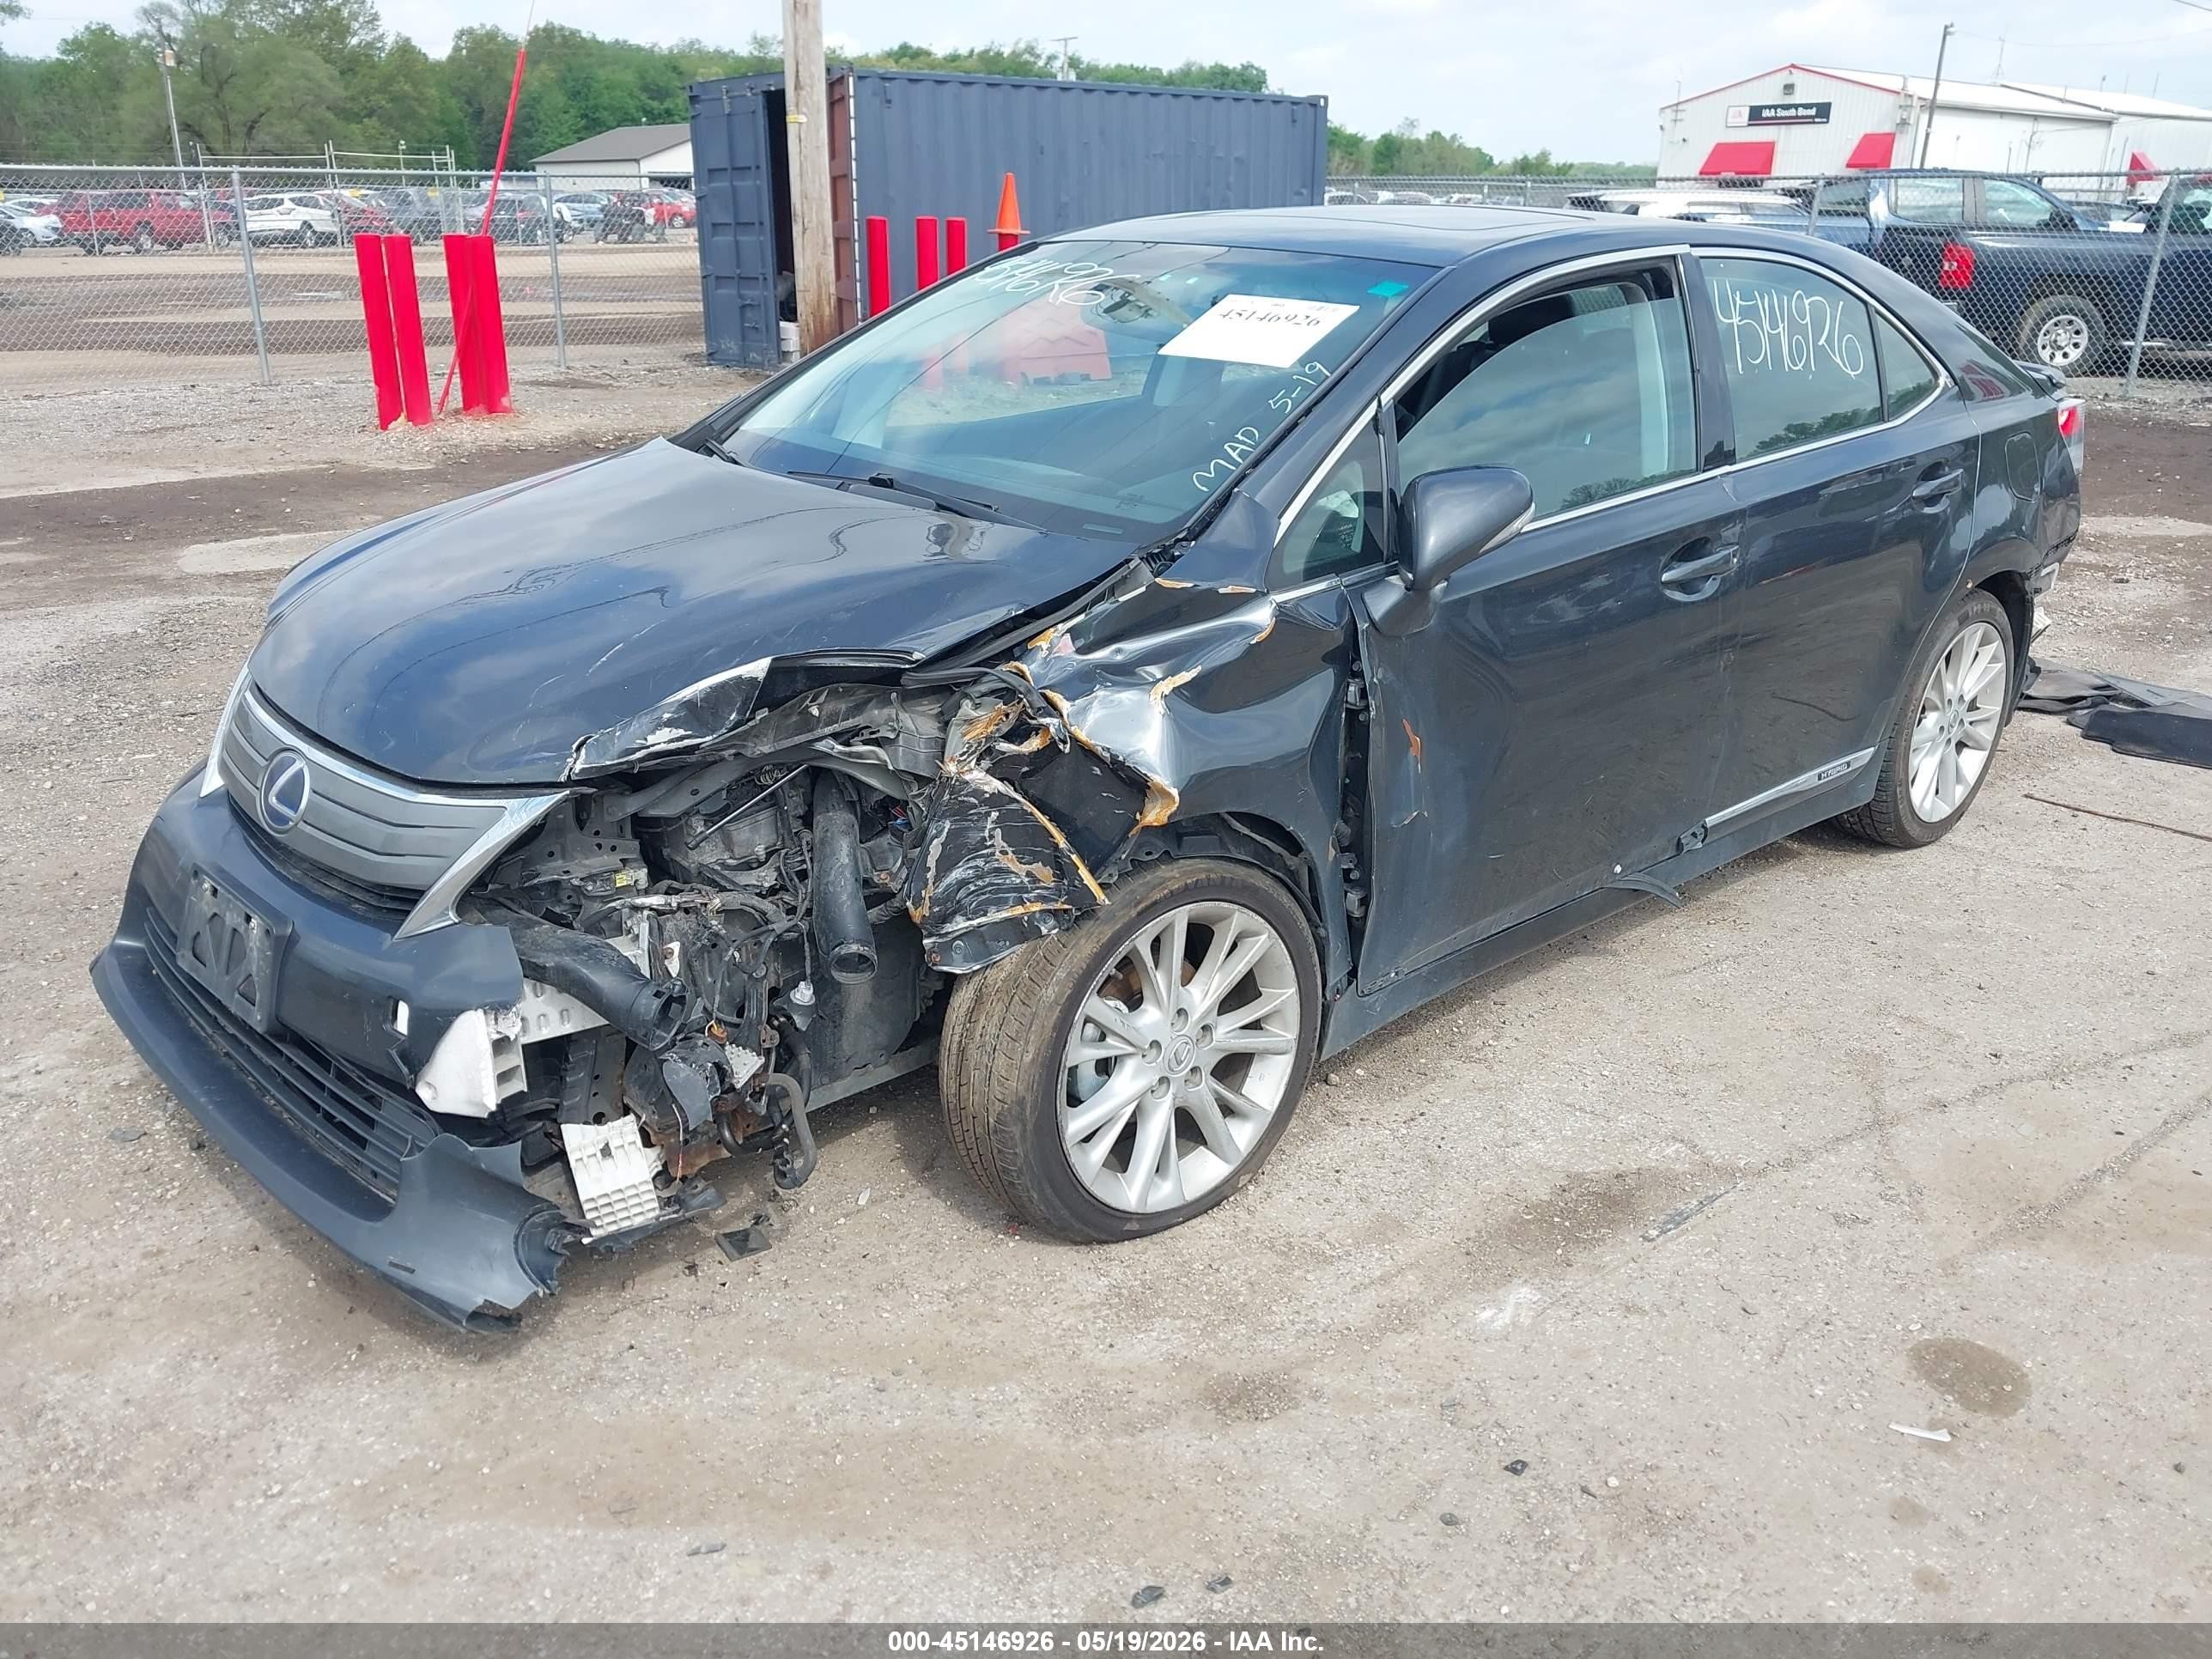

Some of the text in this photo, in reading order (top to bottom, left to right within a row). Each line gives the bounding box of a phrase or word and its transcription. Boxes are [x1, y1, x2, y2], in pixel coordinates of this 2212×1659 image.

[1776, 107, 1796, 118] South
[1712, 279, 1864, 379] 45146926
[1193, 362, 1332, 492] MAD 5-19
